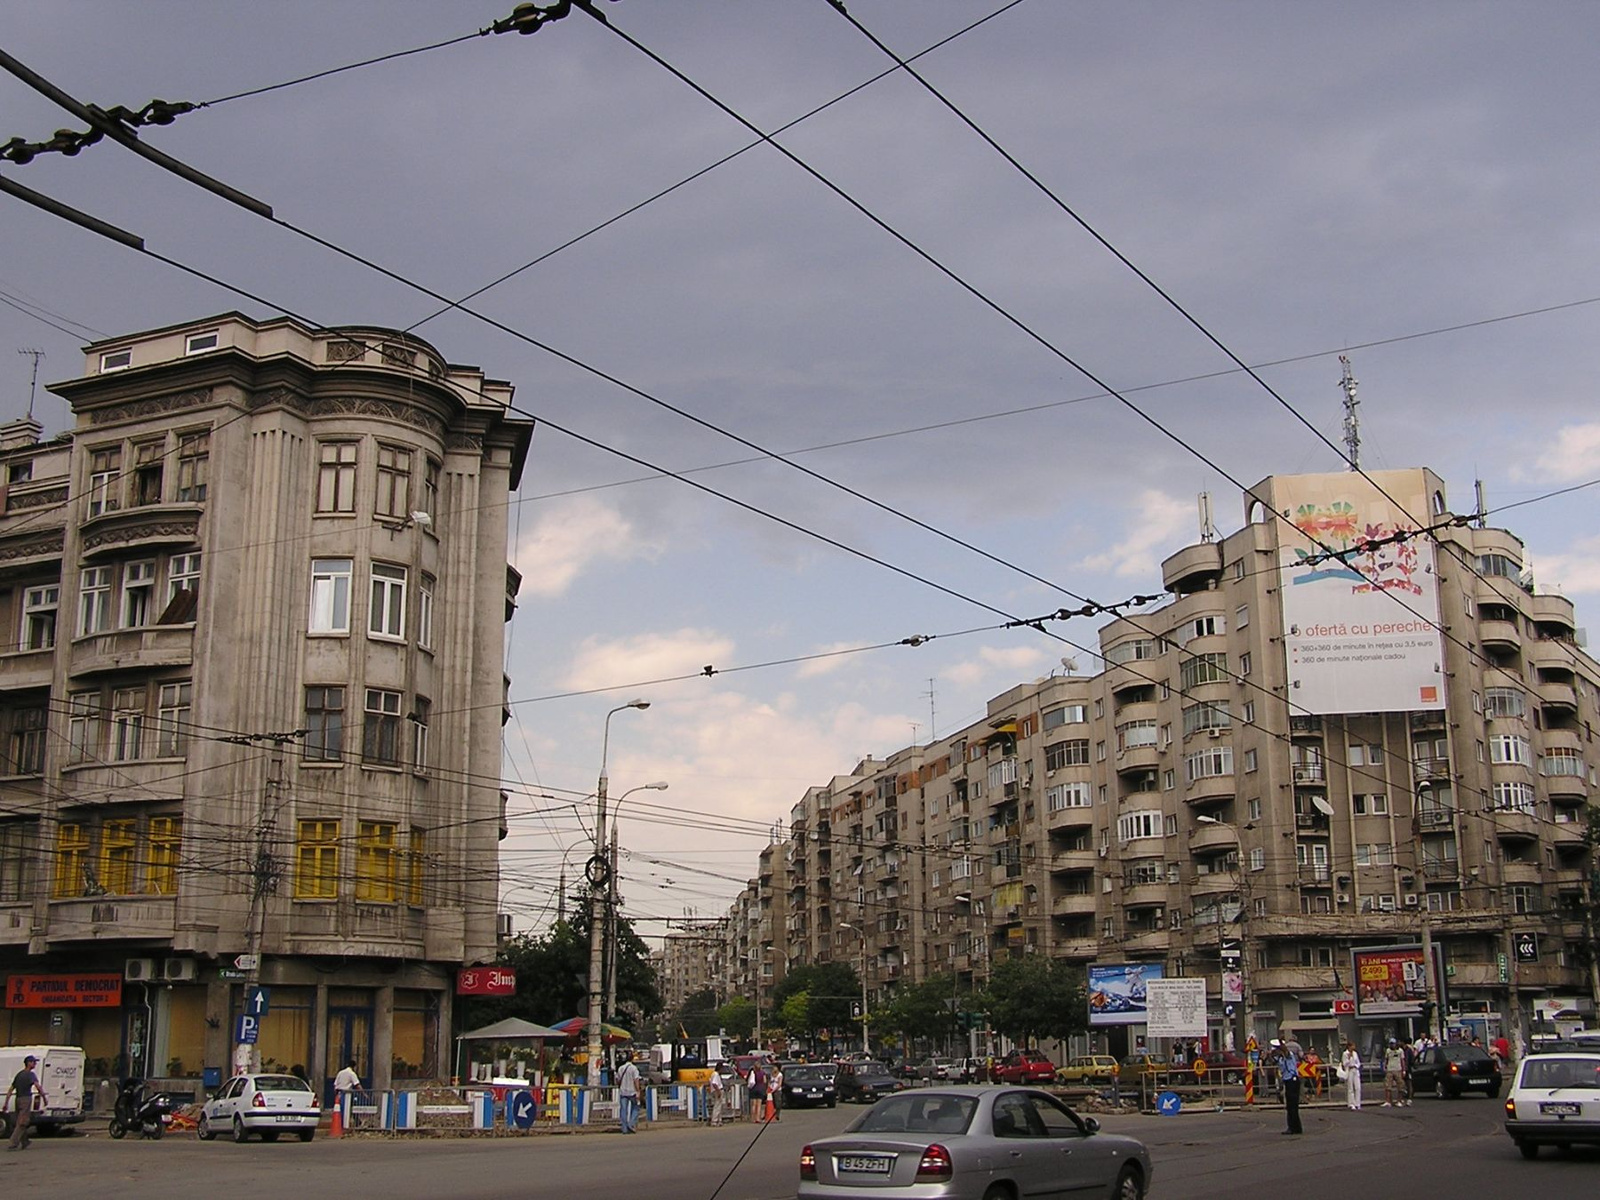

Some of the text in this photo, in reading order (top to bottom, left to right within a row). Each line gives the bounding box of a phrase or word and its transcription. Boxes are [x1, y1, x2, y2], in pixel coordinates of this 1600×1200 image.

[1305, 623, 1347, 637] ofertă
[1351, 625, 1369, 635] cu
[1373, 620, 1431, 636] pereche
[1301, 644, 1331, 652] 360+360
[1332, 643, 1341, 651] de
[1342, 642, 1366, 650] minute
[1404, 640, 1416, 648] 3,5
[1301, 656, 1315, 664] 360
[1316, 655, 1325, 663] de
[30, 979, 120, 992] PARTIDUL DEMOCRAT
[240, 1015, 255, 1039] P
[845, 1158, 885, 1169] B 45 ZFH
